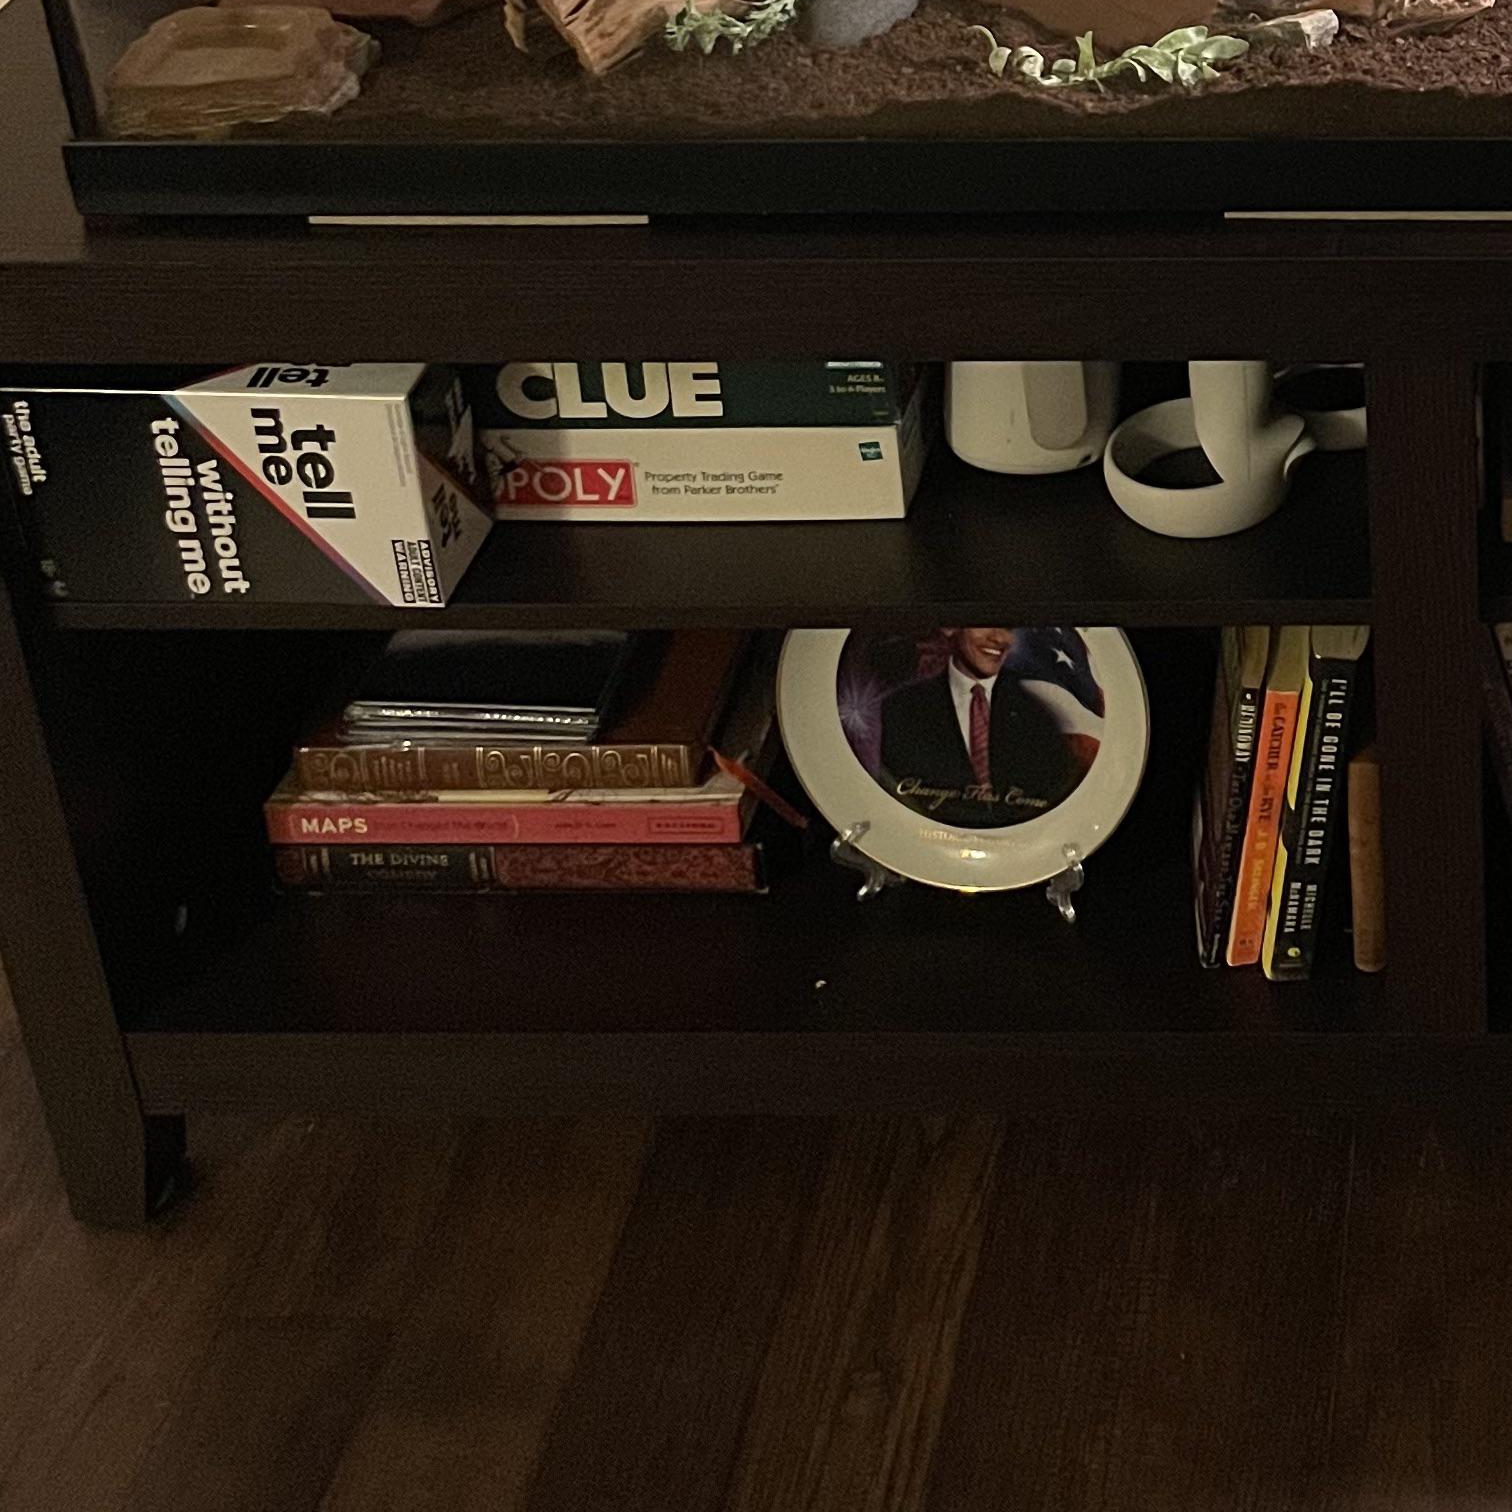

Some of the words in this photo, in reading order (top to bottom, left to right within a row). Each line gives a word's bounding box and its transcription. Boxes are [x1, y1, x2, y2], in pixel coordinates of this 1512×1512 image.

[246, 367, 330, 388] tell
[496, 361, 724, 421] CLUE
[22, 434, 48, 483] adult
[250, 407, 294, 486] me
[290, 424, 357, 520] tell
[645, 471, 697, 483] Property
[701, 471, 745, 484] Trading
[748, 471, 784, 481] Game
[150, 416, 199, 533] telling
[178, 538, 212, 595] me
[651, 485, 681, 495] from
[684, 485, 722, 495] Parker
[196, 458, 251, 595] without
[394, 541, 416, 603] WARNING
[418, 541, 442, 603] ADVISORY
[1328, 678, 1349, 705] I'LL
[1325, 711, 1344, 729] BE
[1267, 716, 1286, 770] CATCHER
[1318, 735, 1340, 770] GONE
[896, 777, 960, 811] Change
[1315, 777, 1333, 792] IN
[301, 817, 369, 834] MAPS
[1258, 797, 1274, 821] RYE
[1310, 799, 1331, 823] THE
[350, 851, 386, 867] THE
[389, 852, 451, 868] DIVINE
[1303, 829, 1326, 866] DARK
[1299, 884, 1318, 930] MICHELLE
